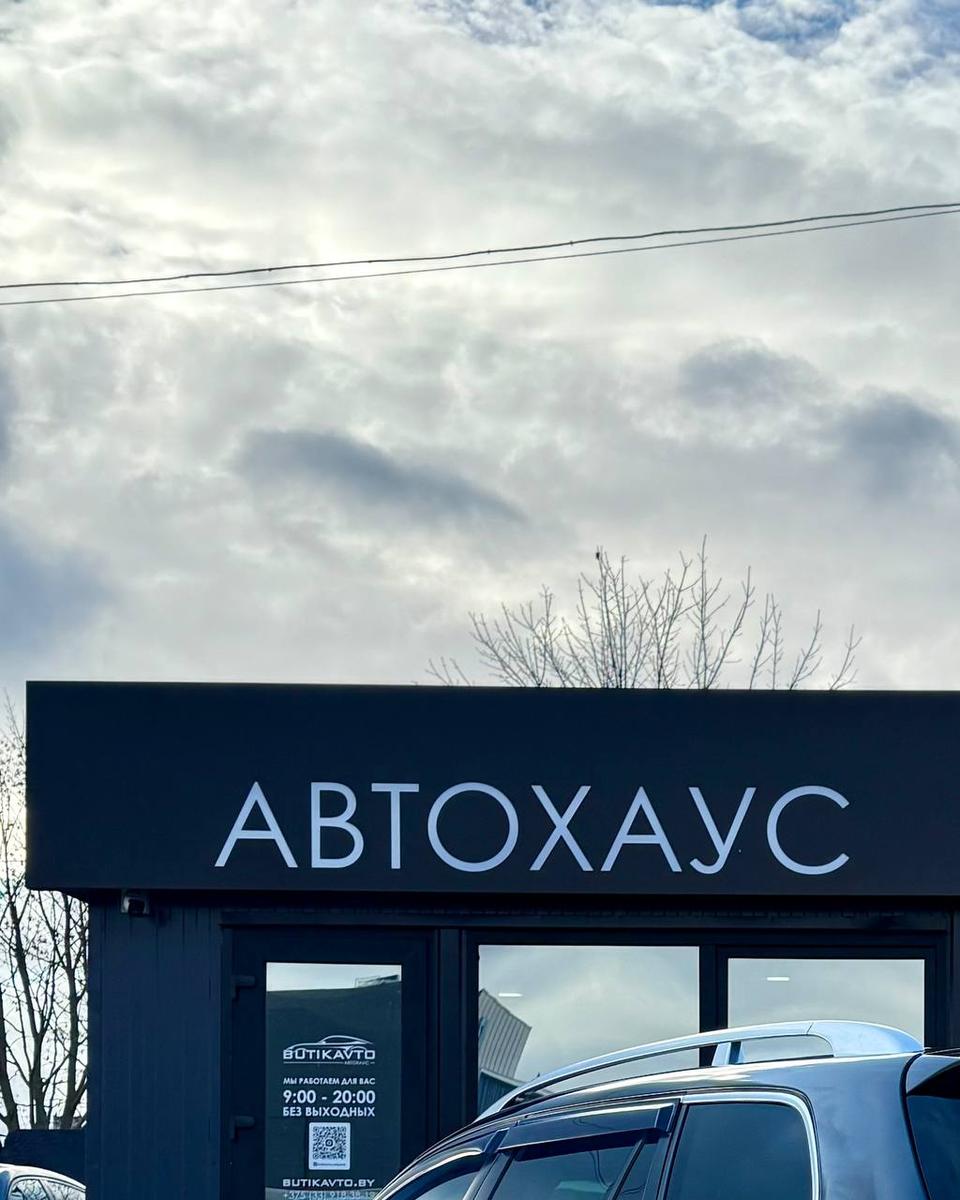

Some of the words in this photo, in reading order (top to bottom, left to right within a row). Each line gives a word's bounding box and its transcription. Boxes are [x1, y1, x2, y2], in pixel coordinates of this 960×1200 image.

[214, 781, 850, 875] АВТОХАУС
[282, 1049, 376, 1060] BUTIKAVTO
[283, 1077, 297, 1085] МЫ
[299, 1077, 340, 1085] РАБОТАЕМ
[341, 1077, 357, 1086] ДЛЯ
[359, 1077, 376, 1085] ВАС
[282, 1089, 317, 1104] 9:00
[332, 1089, 376, 1104] 20:00
[283, 1106, 302, 1117] БЕЗ
[305, 1106, 376, 1118] ВЫХОДНЫХ
[282, 1179, 375, 1187] BUTIKAVTO.BY
